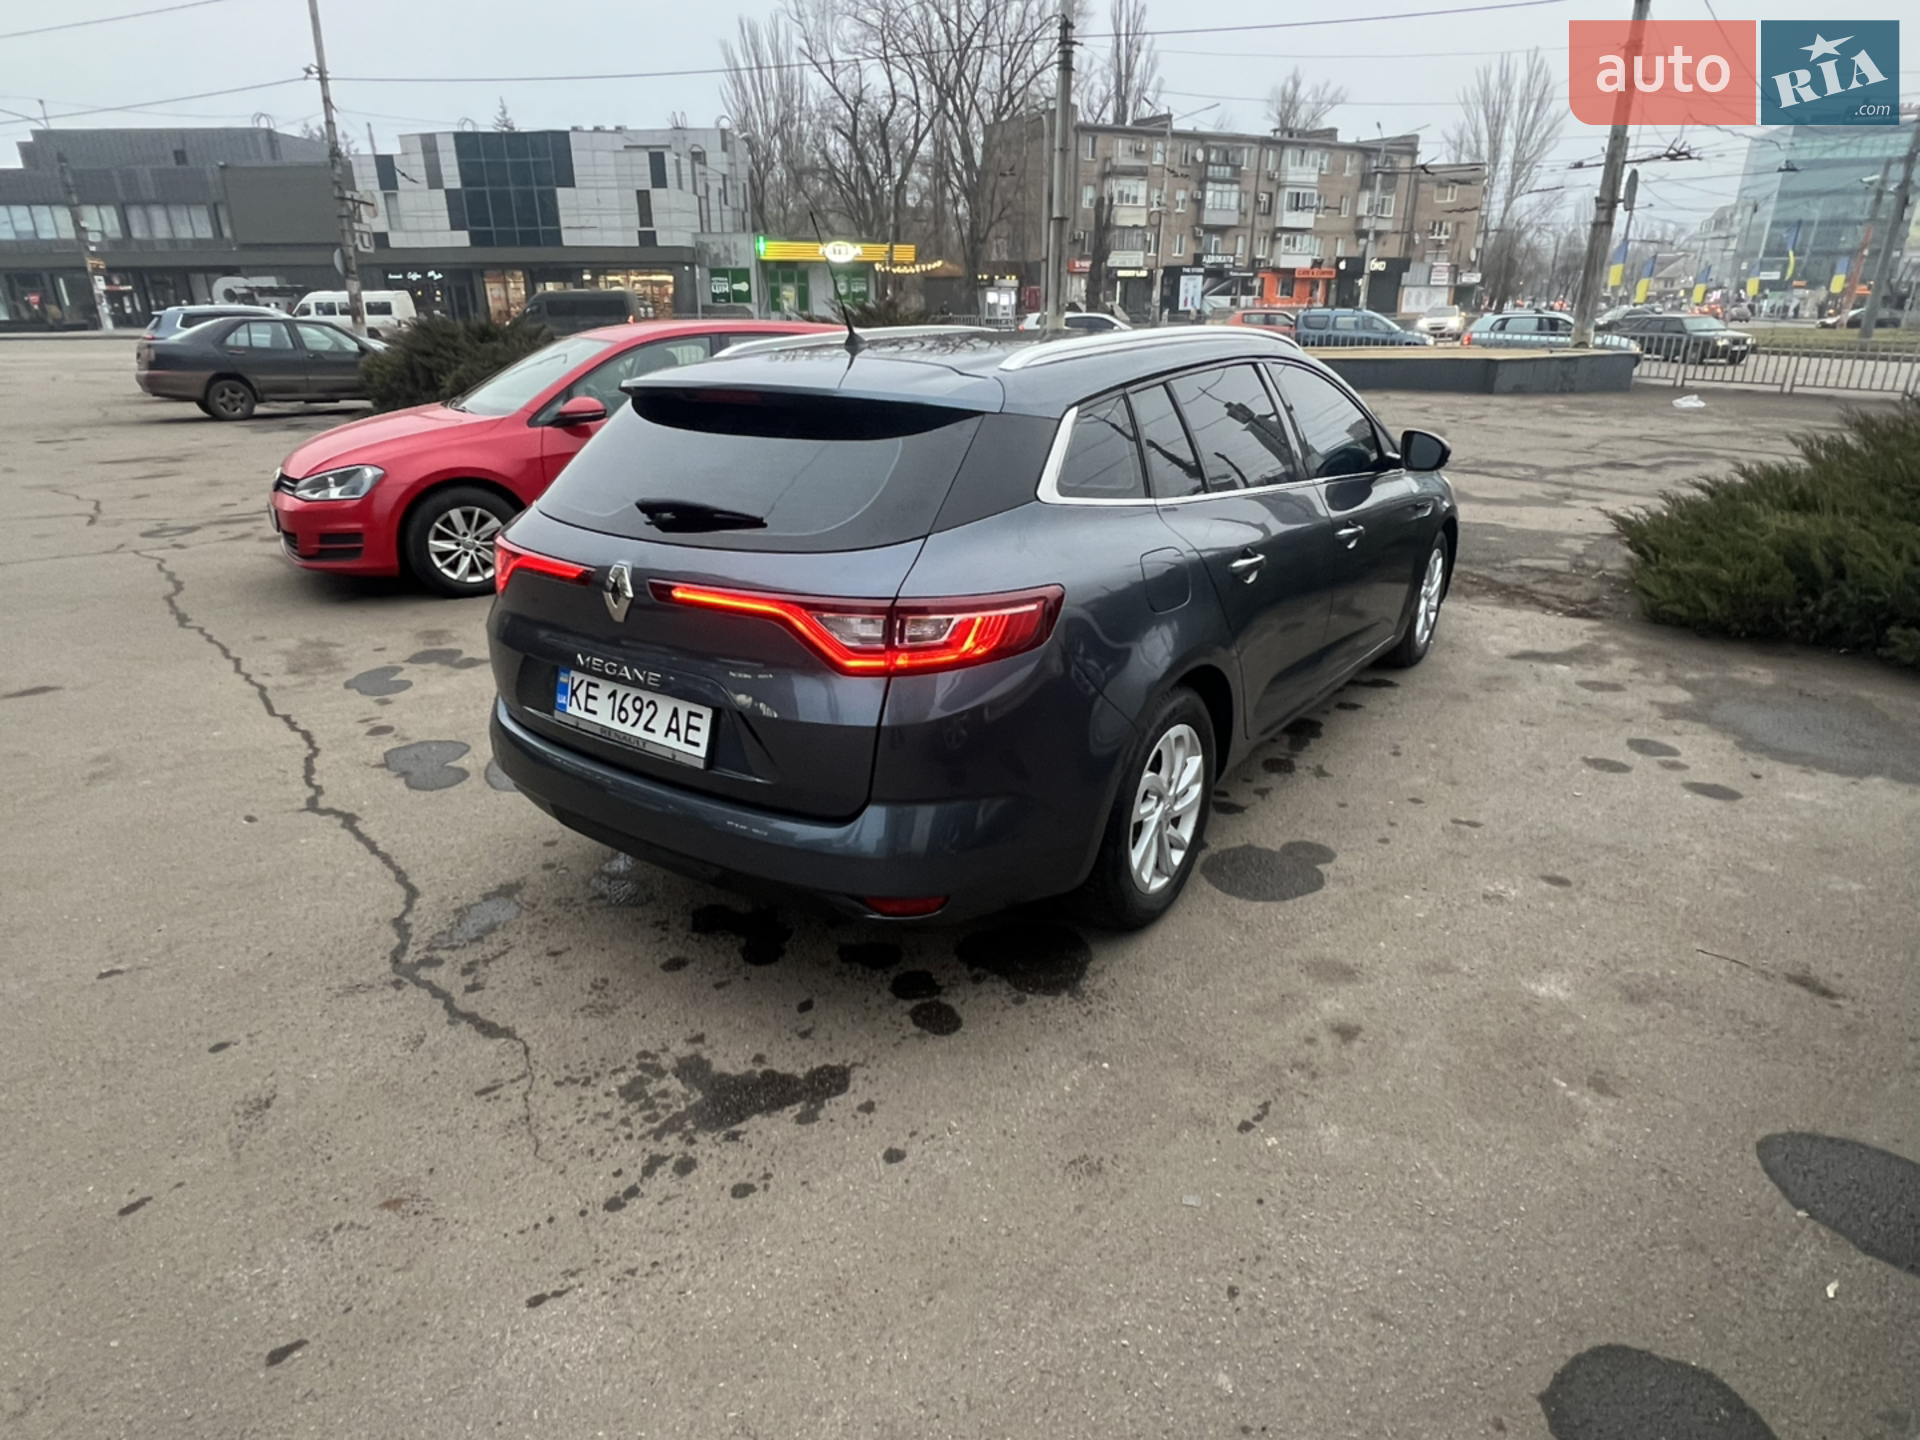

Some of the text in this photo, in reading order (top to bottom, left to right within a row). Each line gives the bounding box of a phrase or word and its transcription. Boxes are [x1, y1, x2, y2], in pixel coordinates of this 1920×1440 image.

[576, 652, 661, 687] MEGANE
[568, 675, 704, 748] KE 1692 AE
[600, 727, 648, 749] RENAULT
